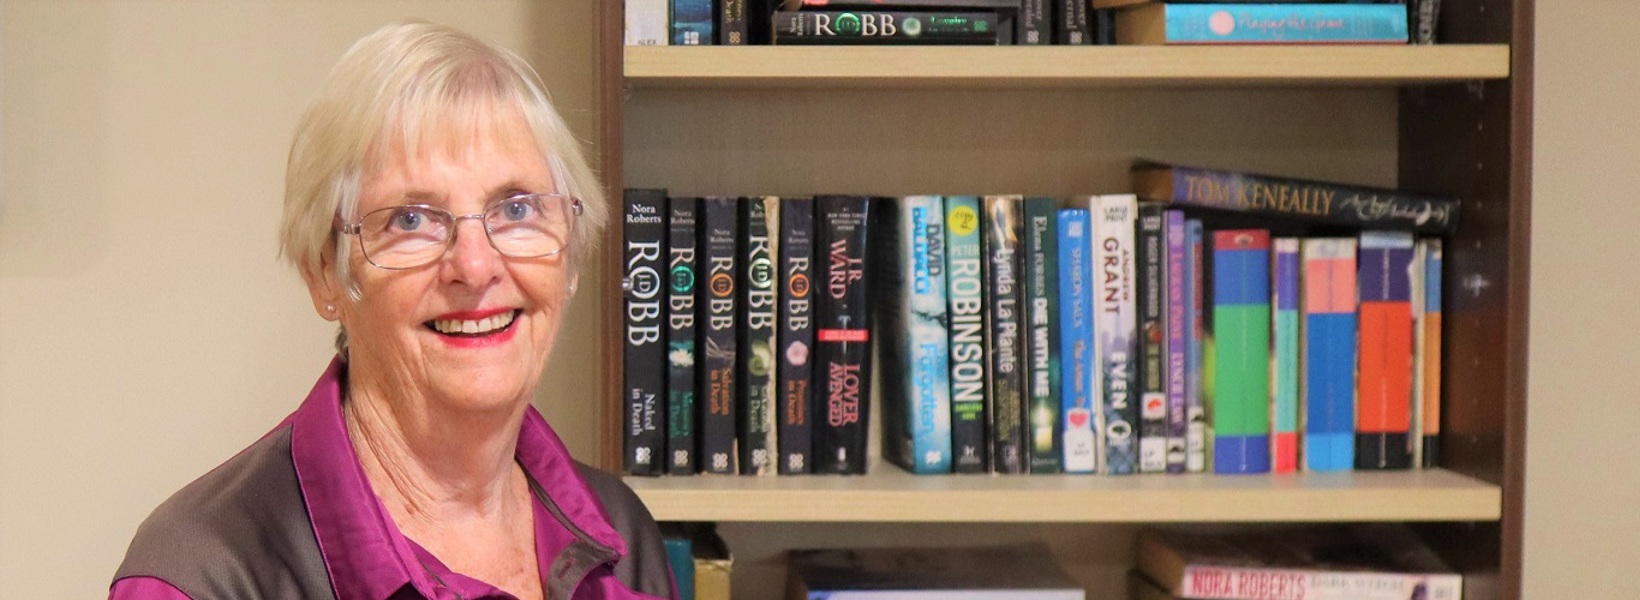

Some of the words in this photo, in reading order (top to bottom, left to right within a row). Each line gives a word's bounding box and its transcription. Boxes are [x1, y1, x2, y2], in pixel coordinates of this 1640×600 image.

[814, 12, 897, 37] ROBB
[632, 203, 657, 214] Nora
[674, 209, 692, 217] Nora
[1105, 206, 1129, 214] LARGE
[1186, 175, 1231, 201] TOM
[1237, 178, 1336, 217] KENEALLY
[626, 213, 663, 224] Roberts
[671, 216, 696, 225] Roberts
[713, 228, 731, 236] Nora
[1105, 214, 1129, 222] PRINT
[709, 235, 734, 244] Roberts
[912, 206, 930, 295] BALDACCI
[926, 223, 942, 277] DAVID
[951, 244, 980, 258] PETER
[669, 247, 695, 330] ROBB
[829, 239, 847, 299] WARD
[993, 247, 1016, 295] Lynda
[1103, 237, 1120, 314] GRANT
[1122, 249, 1131, 301] ANDREW
[628, 240, 660, 347] ROBB
[710, 256, 734, 331] ROBB
[788, 256, 810, 332] ROBB
[997, 298, 1016, 320] La
[1032, 297, 1048, 325] DIE
[951, 259, 984, 402] ROBINSON
[997, 322, 1017, 374] Plante
[1033, 327, 1049, 370] WITH
[632, 388, 643, 400] in
[711, 369, 720, 380] in
[721, 367, 732, 416] Salvation
[828, 361, 844, 428] AVENGED
[914, 343, 938, 435] Forgotten
[1034, 371, 1050, 398] ME
[1110, 351, 1128, 410] EVEN
[643, 393, 657, 432] Naked
[711, 383, 720, 415] Death
[842, 363, 861, 427] LOVER
[631, 402, 643, 436] Death
[1193, 568, 1232, 594] NORA
[1239, 571, 1306, 600] ROBERTS
